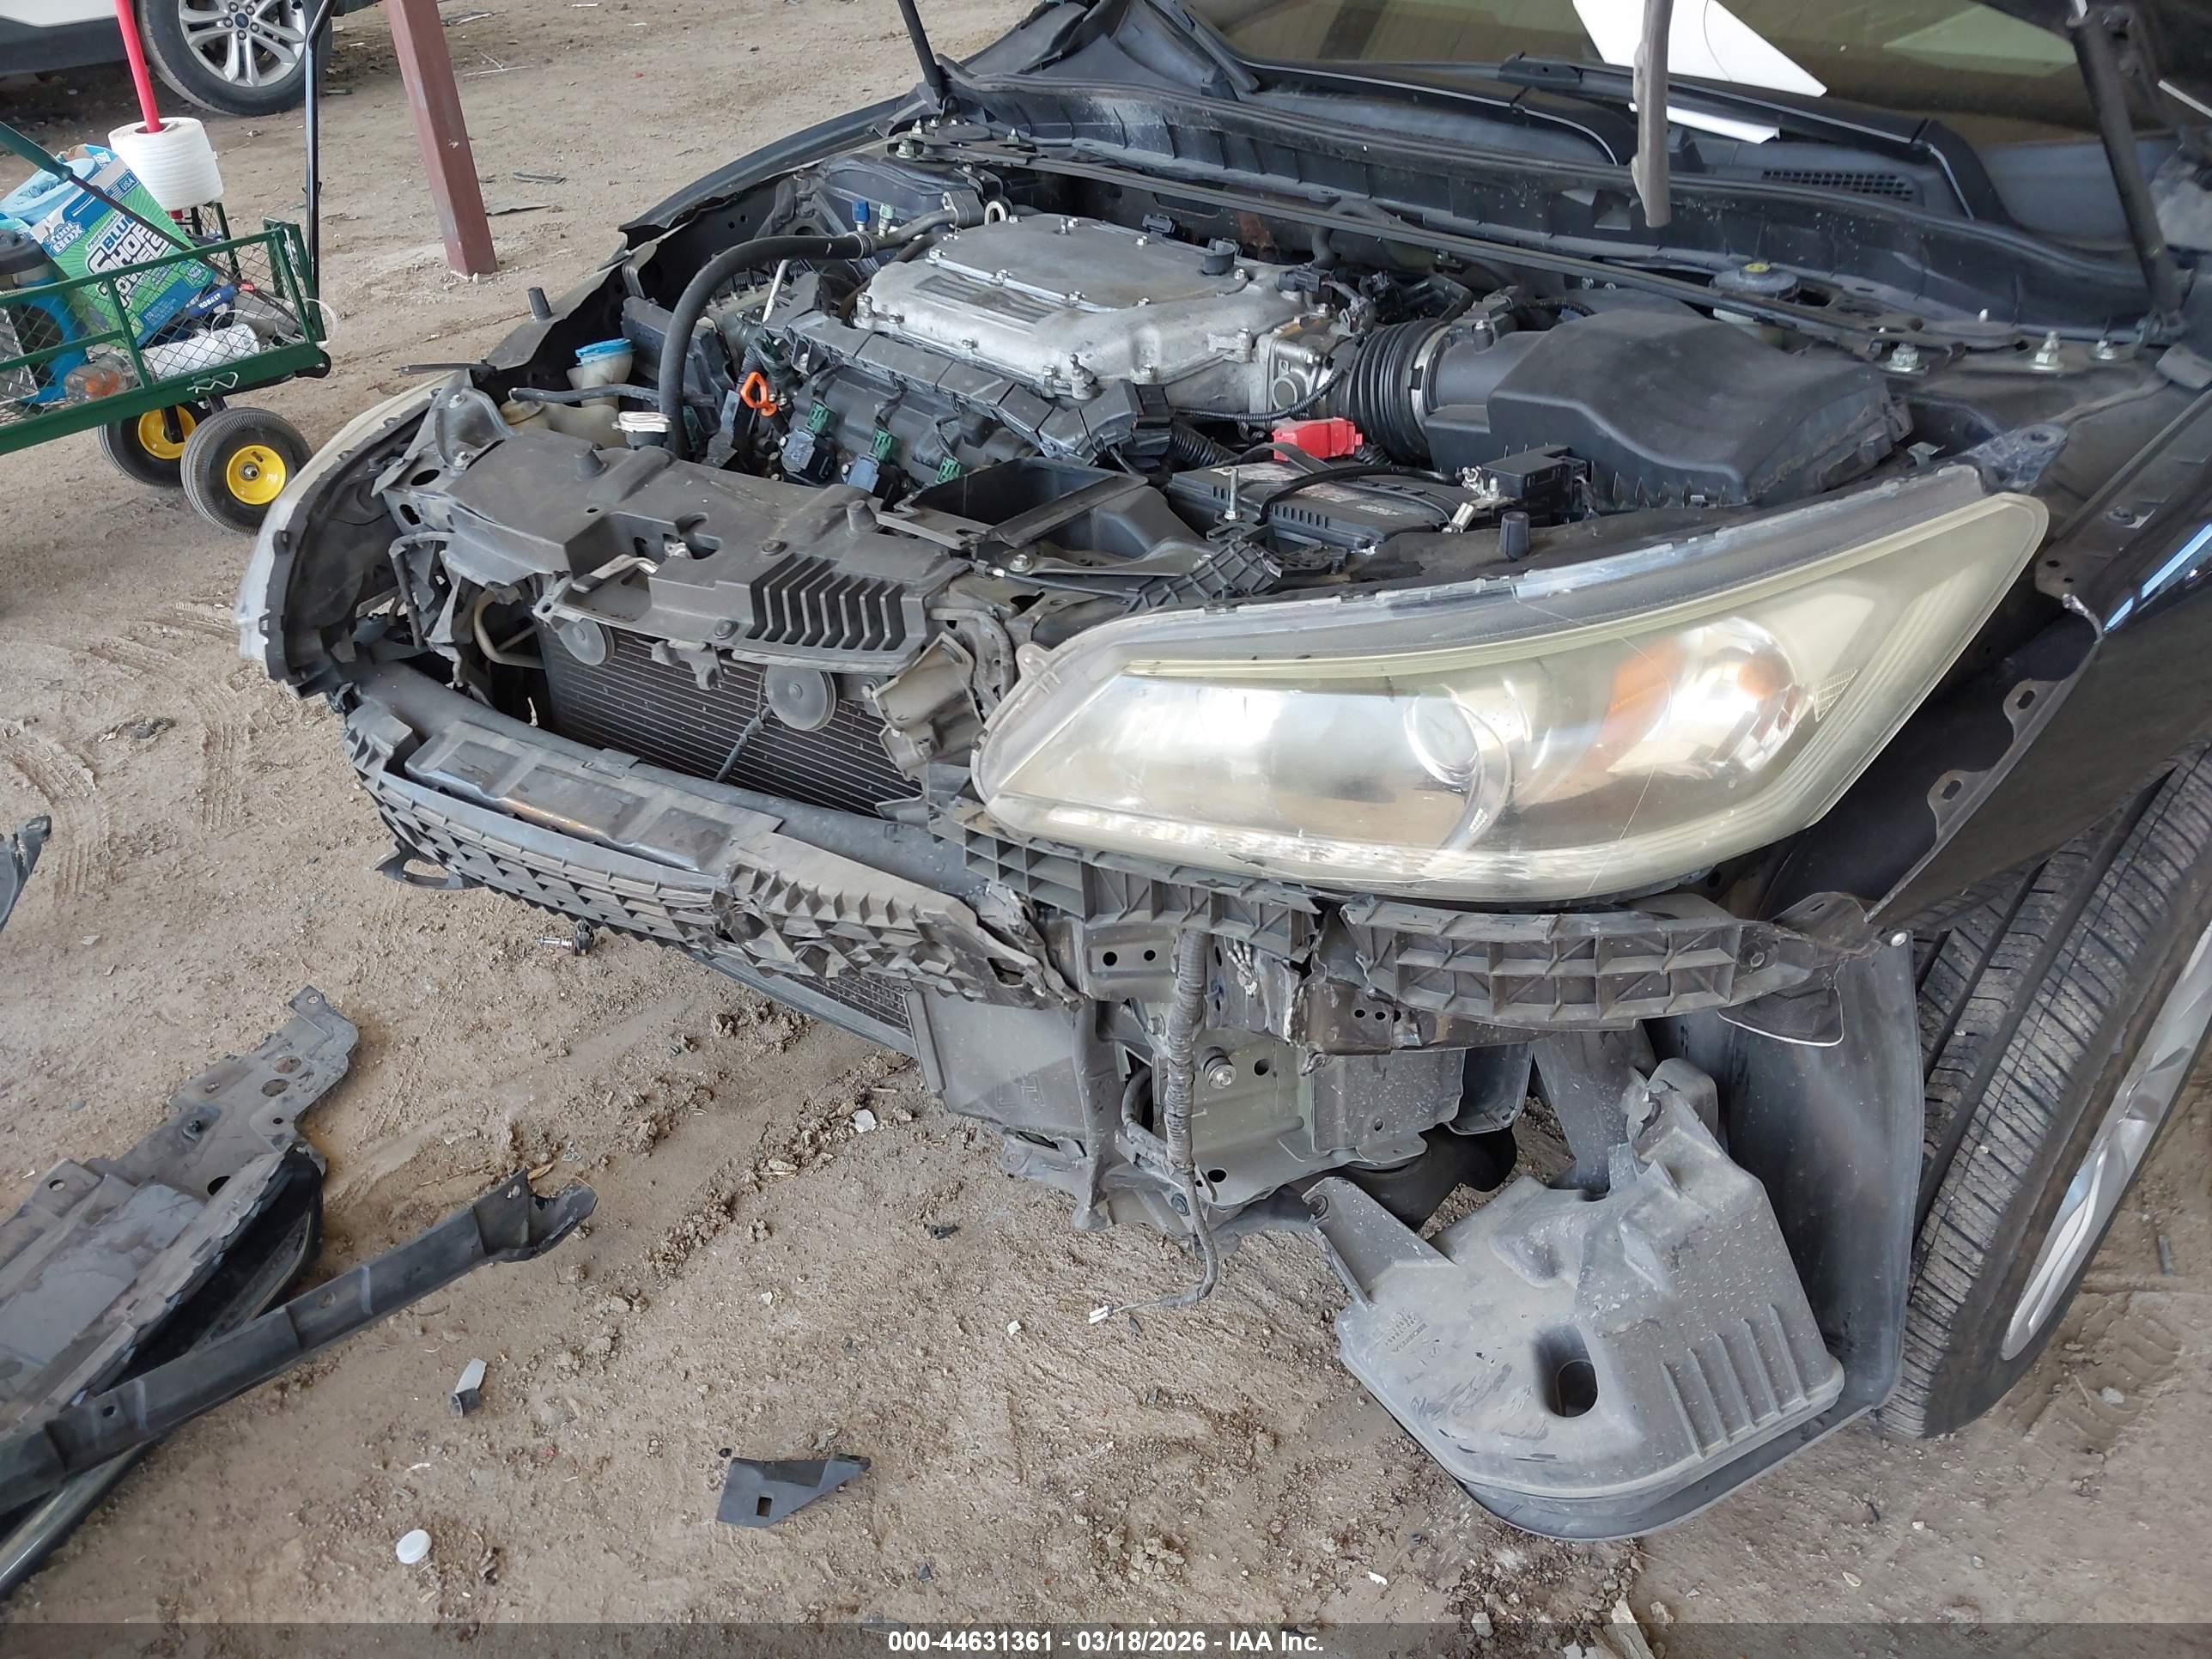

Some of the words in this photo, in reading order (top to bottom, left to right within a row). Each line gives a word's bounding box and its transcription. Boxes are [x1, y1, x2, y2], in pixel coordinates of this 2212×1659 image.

[120, 177, 136, 190] USA
[52, 225, 83, 253] BOX
[87, 212, 118, 248] PROFESSIONAL
